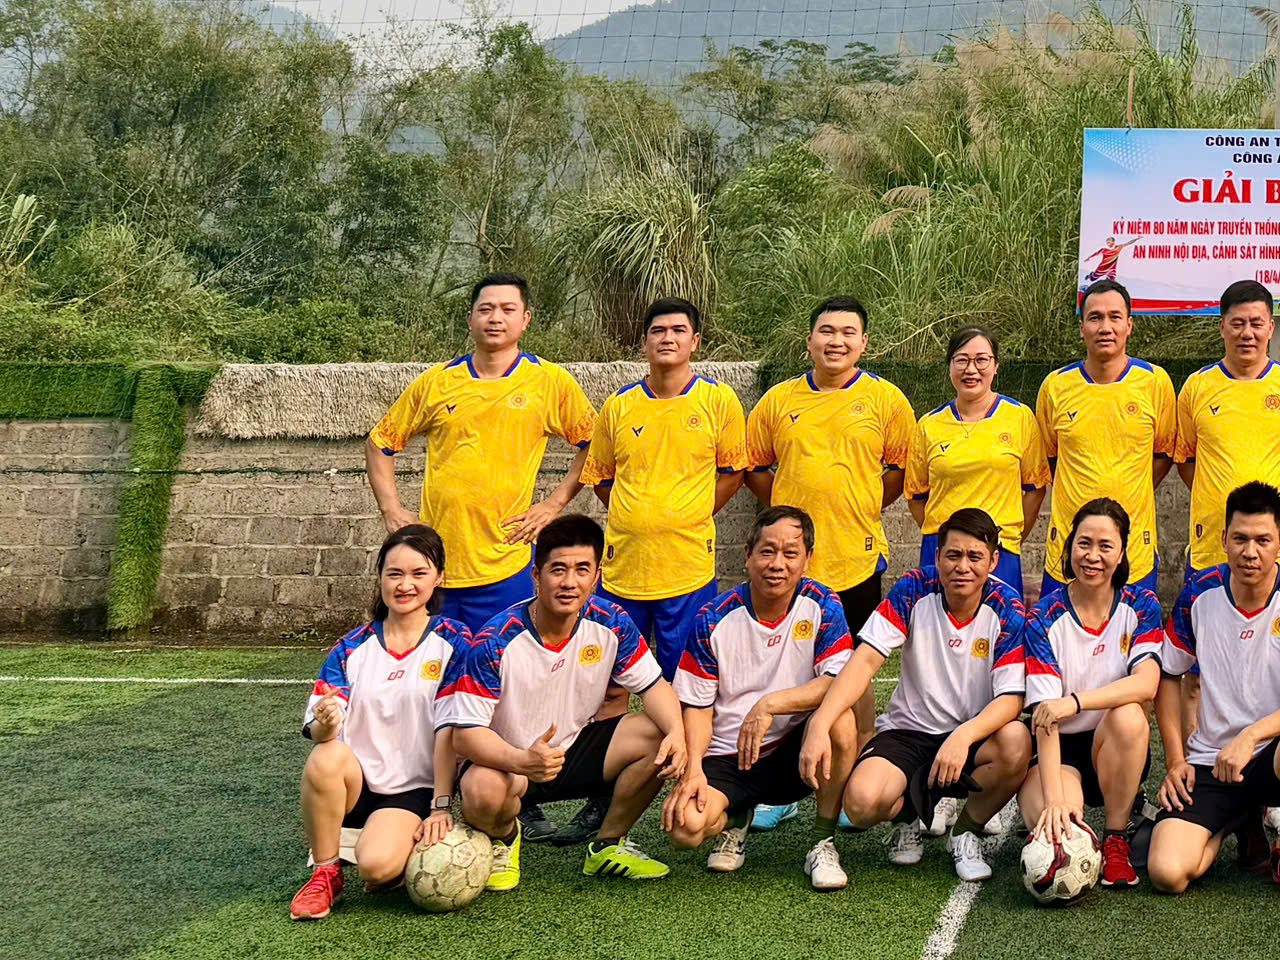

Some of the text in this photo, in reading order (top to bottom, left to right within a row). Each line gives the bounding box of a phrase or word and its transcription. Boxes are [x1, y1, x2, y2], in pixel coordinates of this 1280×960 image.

[1205, 134, 1245, 147] CÔNG
[1249, 137, 1270, 147] AN
[1233, 151, 1273, 164] CÔNG
[1173, 170, 1252, 203] GIẢI
[1153, 221, 1165, 235] 80
[1133, 245, 1146, 259] AN
[1148, 245, 1171, 259] NINH
[1173, 242, 1190, 262] NỘI
[1212, 241, 1237, 260] CẢNH
